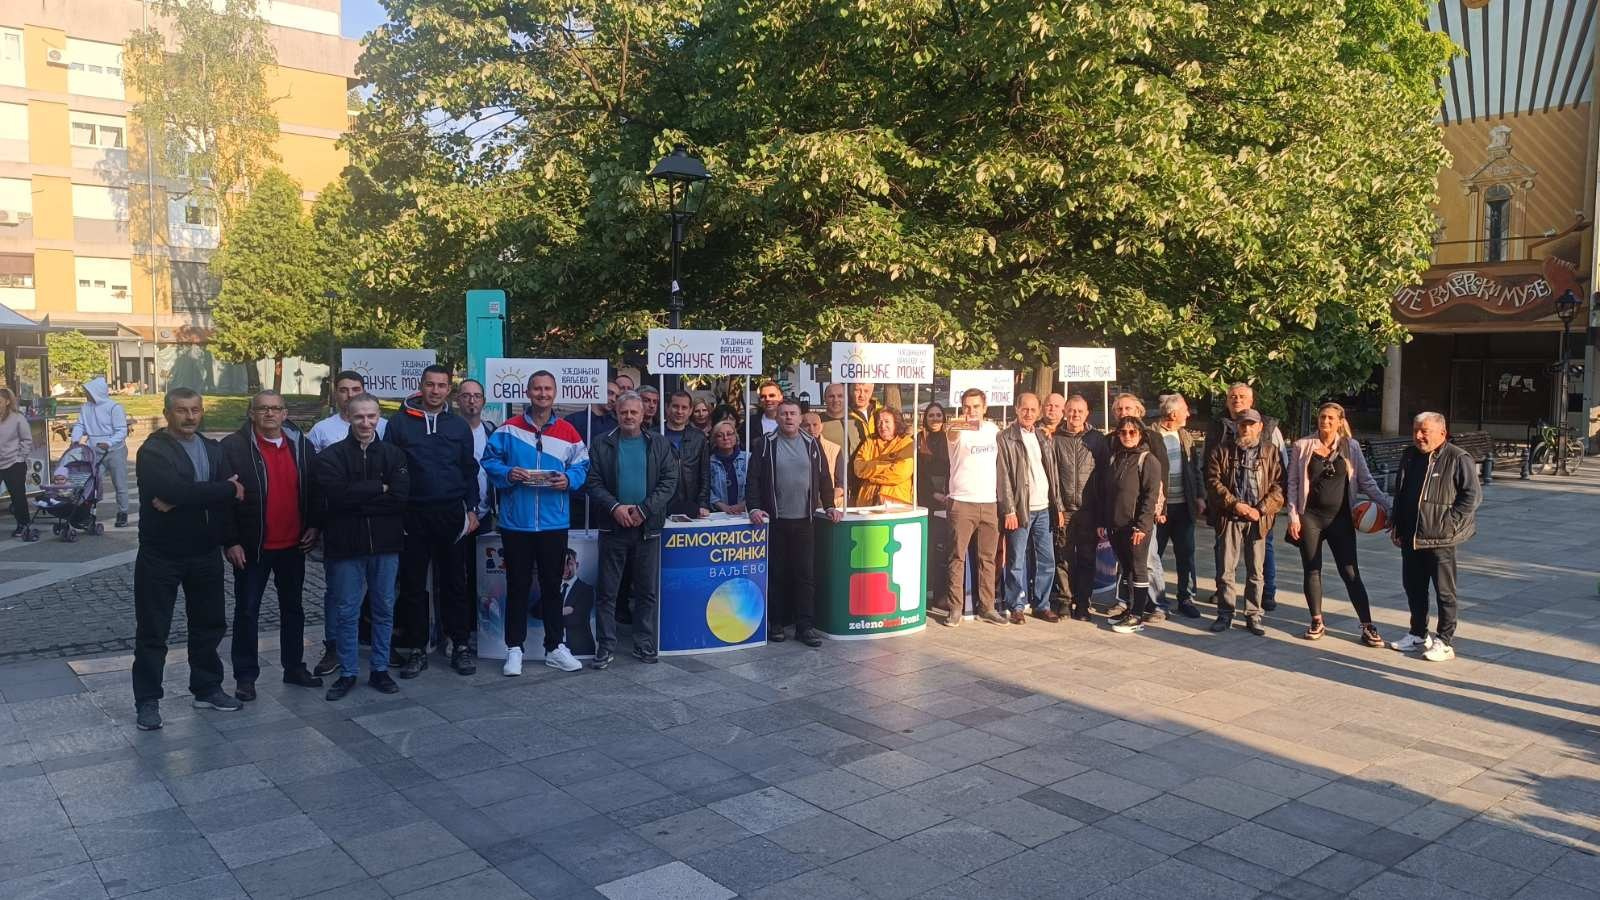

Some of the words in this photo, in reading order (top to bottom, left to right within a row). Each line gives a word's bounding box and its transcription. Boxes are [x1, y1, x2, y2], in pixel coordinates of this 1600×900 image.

[1498, 279, 1551, 307] МУЗЕЈ
[657, 352, 715, 369] СВАНУЋЕ
[720, 355, 753, 369] МОЖЕ
[896, 365, 927, 379] МОЖЕ
[363, 375, 398, 391] АНУЋЕ
[402, 377, 421, 391] МО
[493, 382, 528, 399] СВАН
[562, 385, 600, 400] МОЖЕ
[665, 528, 766, 548] ДЕМОКРАТСКА
[710, 545, 766, 563] СТРАНКА
[709, 563, 765, 578] ВАЉЕВО
